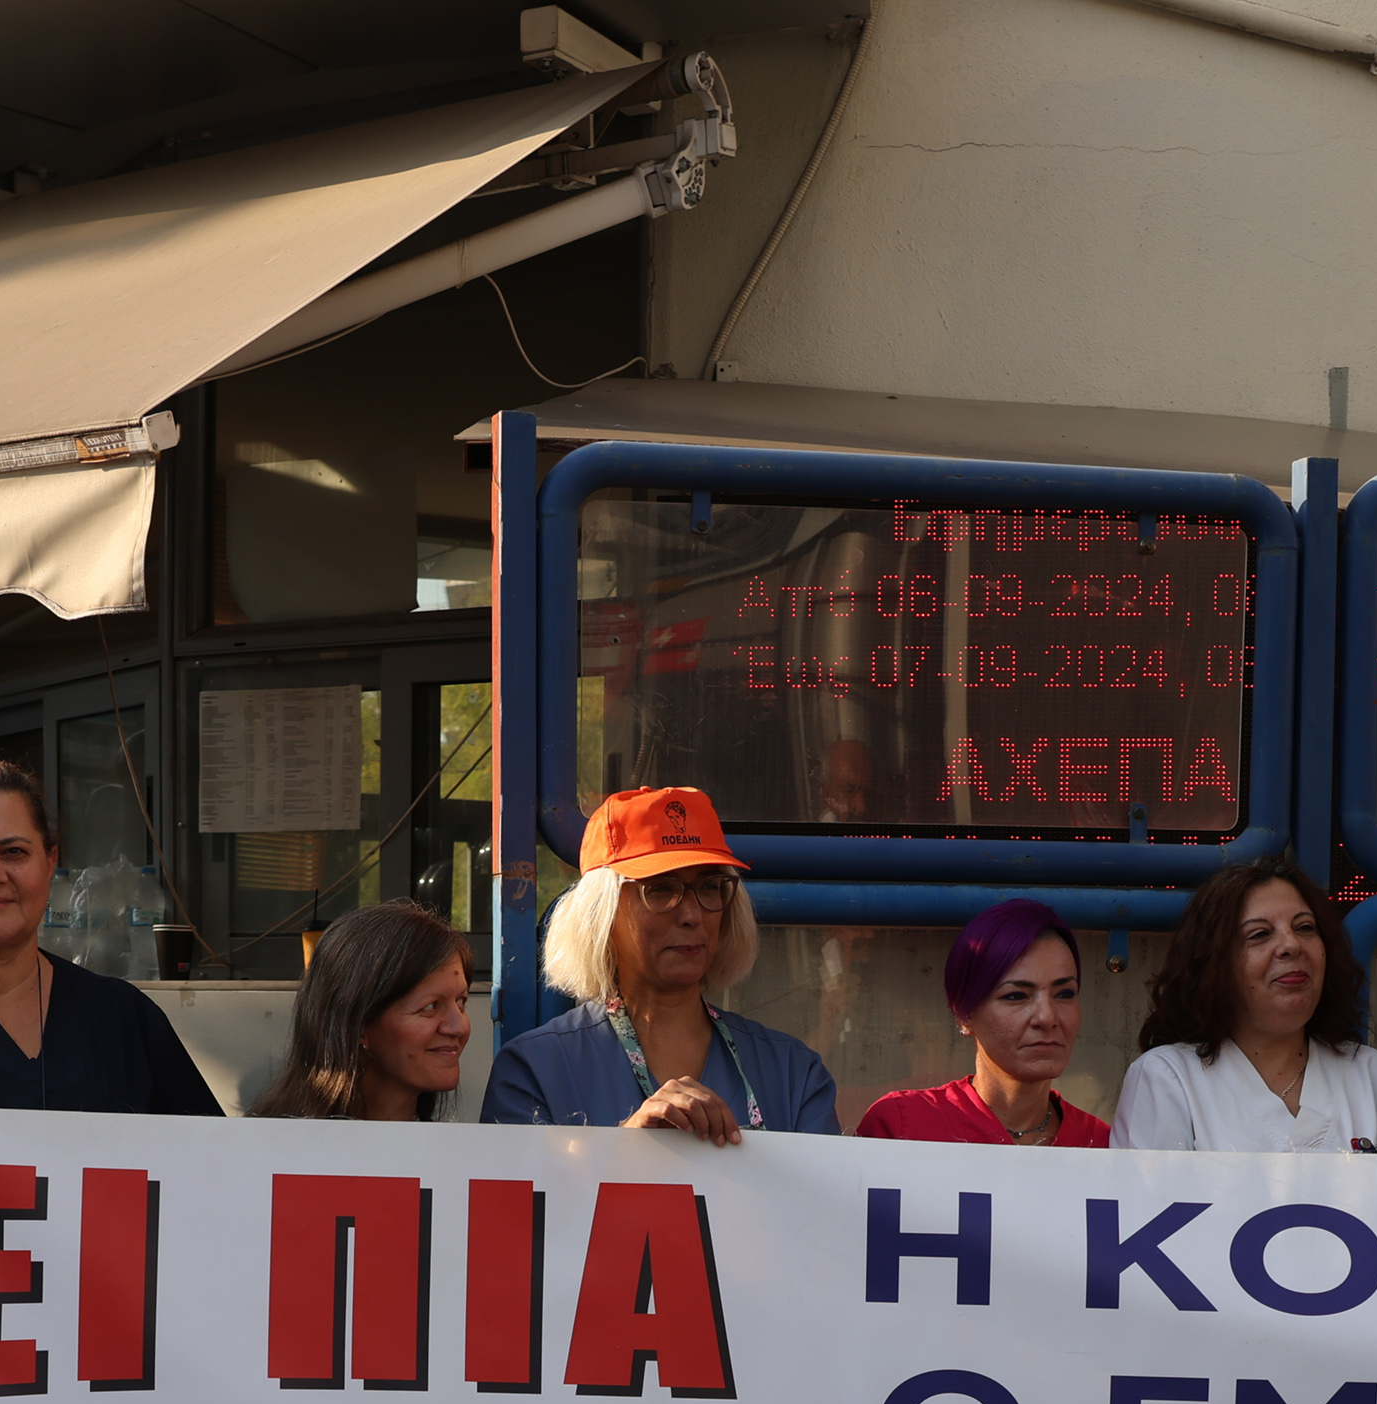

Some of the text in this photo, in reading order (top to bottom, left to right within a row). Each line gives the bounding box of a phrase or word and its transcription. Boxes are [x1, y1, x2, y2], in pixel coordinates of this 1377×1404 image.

[738, 568, 856, 617] Από
[876, 573, 1191, 627] 06-09-2024,
[732, 644, 850, 698] Έως
[870, 644, 1185, 698] 07-09-2024,
[935, 737, 1237, 802] ΑΧΕΠΑ
[662, 835, 701, 845] ΠΟΕΔΗΝ
[865, 1187, 992, 1305] Η
[267, 1173, 737, 1400] ΠΙΑ
